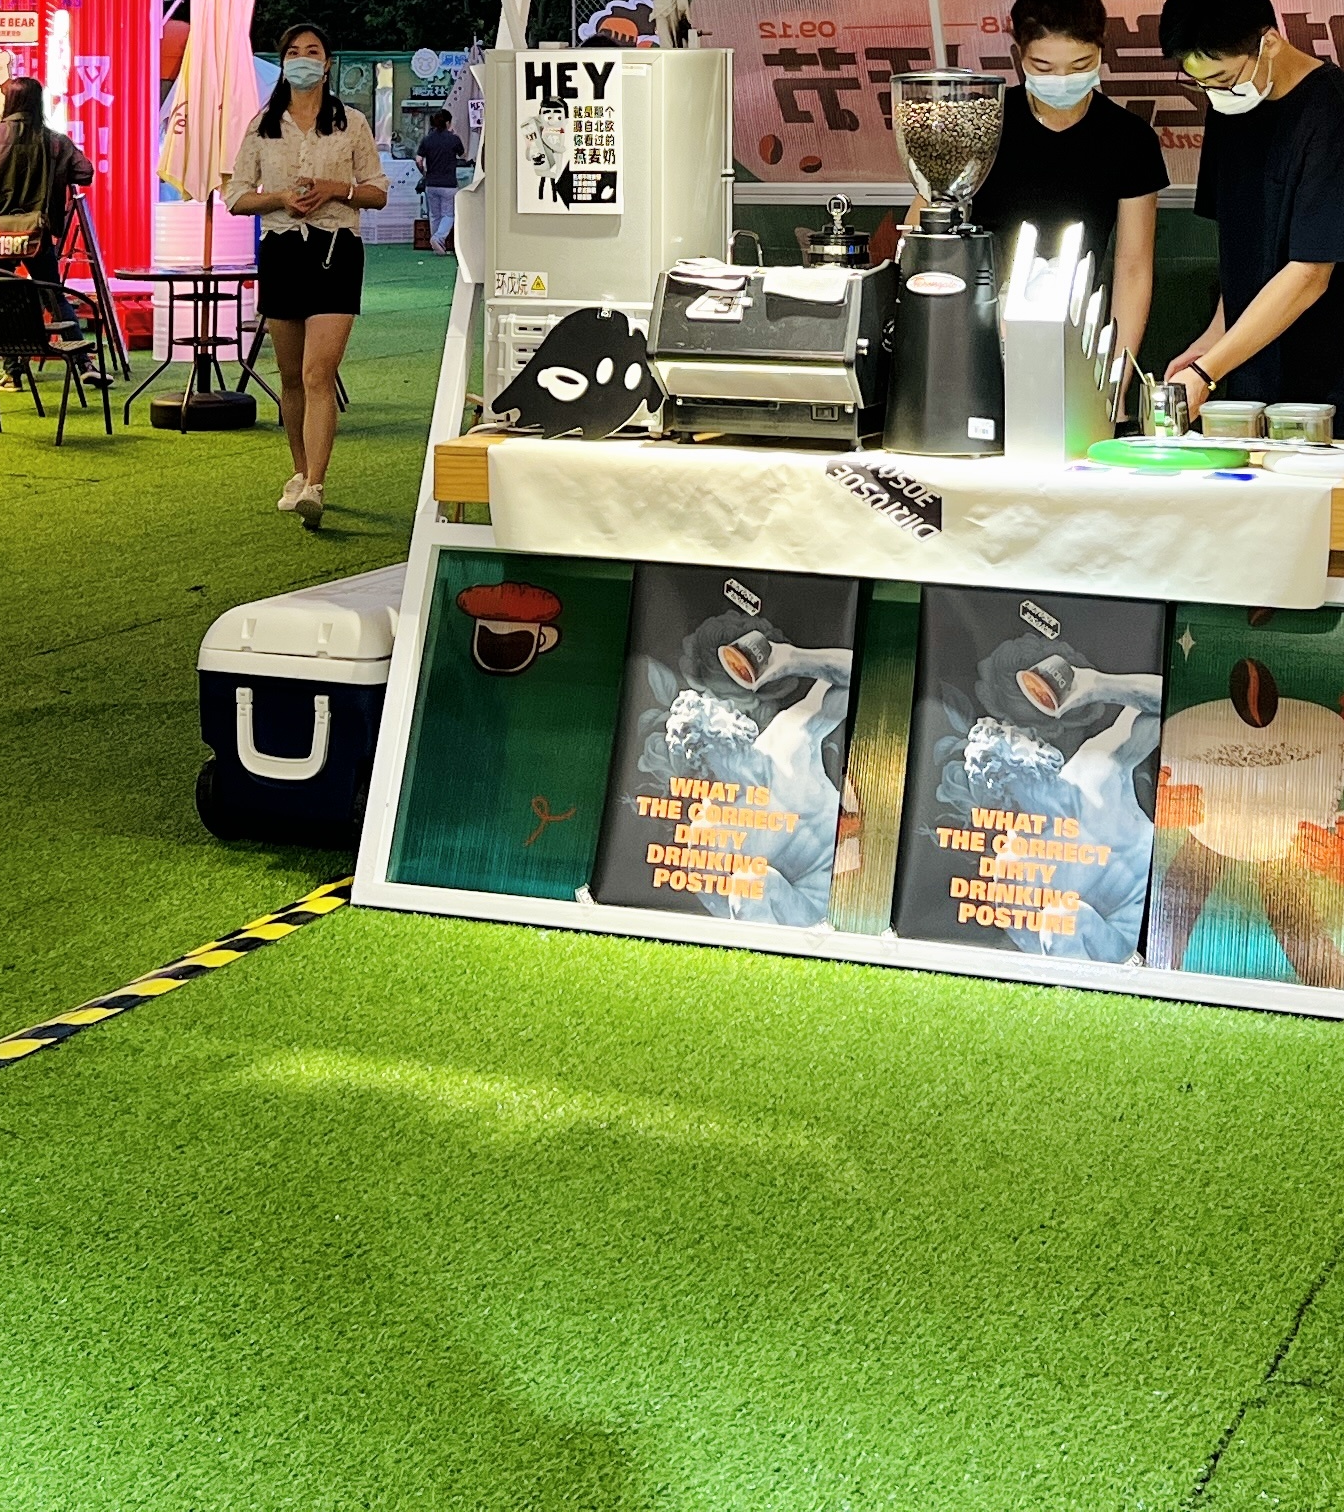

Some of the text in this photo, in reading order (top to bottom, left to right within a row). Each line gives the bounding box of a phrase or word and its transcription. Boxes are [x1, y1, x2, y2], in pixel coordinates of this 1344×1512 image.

[8, 17, 36, 28] BEAR
[524, 61, 616, 101] HEY
[572, 105, 615, 119] 就是那个
[573, 134, 616, 147] 你看过的
[573, 148, 617, 165] 燕麦奶
[669, 776, 771, 807] WHAT IS
[636, 795, 801, 833] THE CORRECT
[971, 807, 1080, 838] WHAT IS
[673, 823, 748, 851] DIRTY
[935, 827, 1112, 866] THE CORRECT
[645, 843, 769, 877] DRINKING
[978, 855, 1058, 884] DIRTY
[653, 867, 765, 900] POSTURE
[949, 877, 1080, 912] DRINKING
[957, 901, 1077, 936] POSTURE
